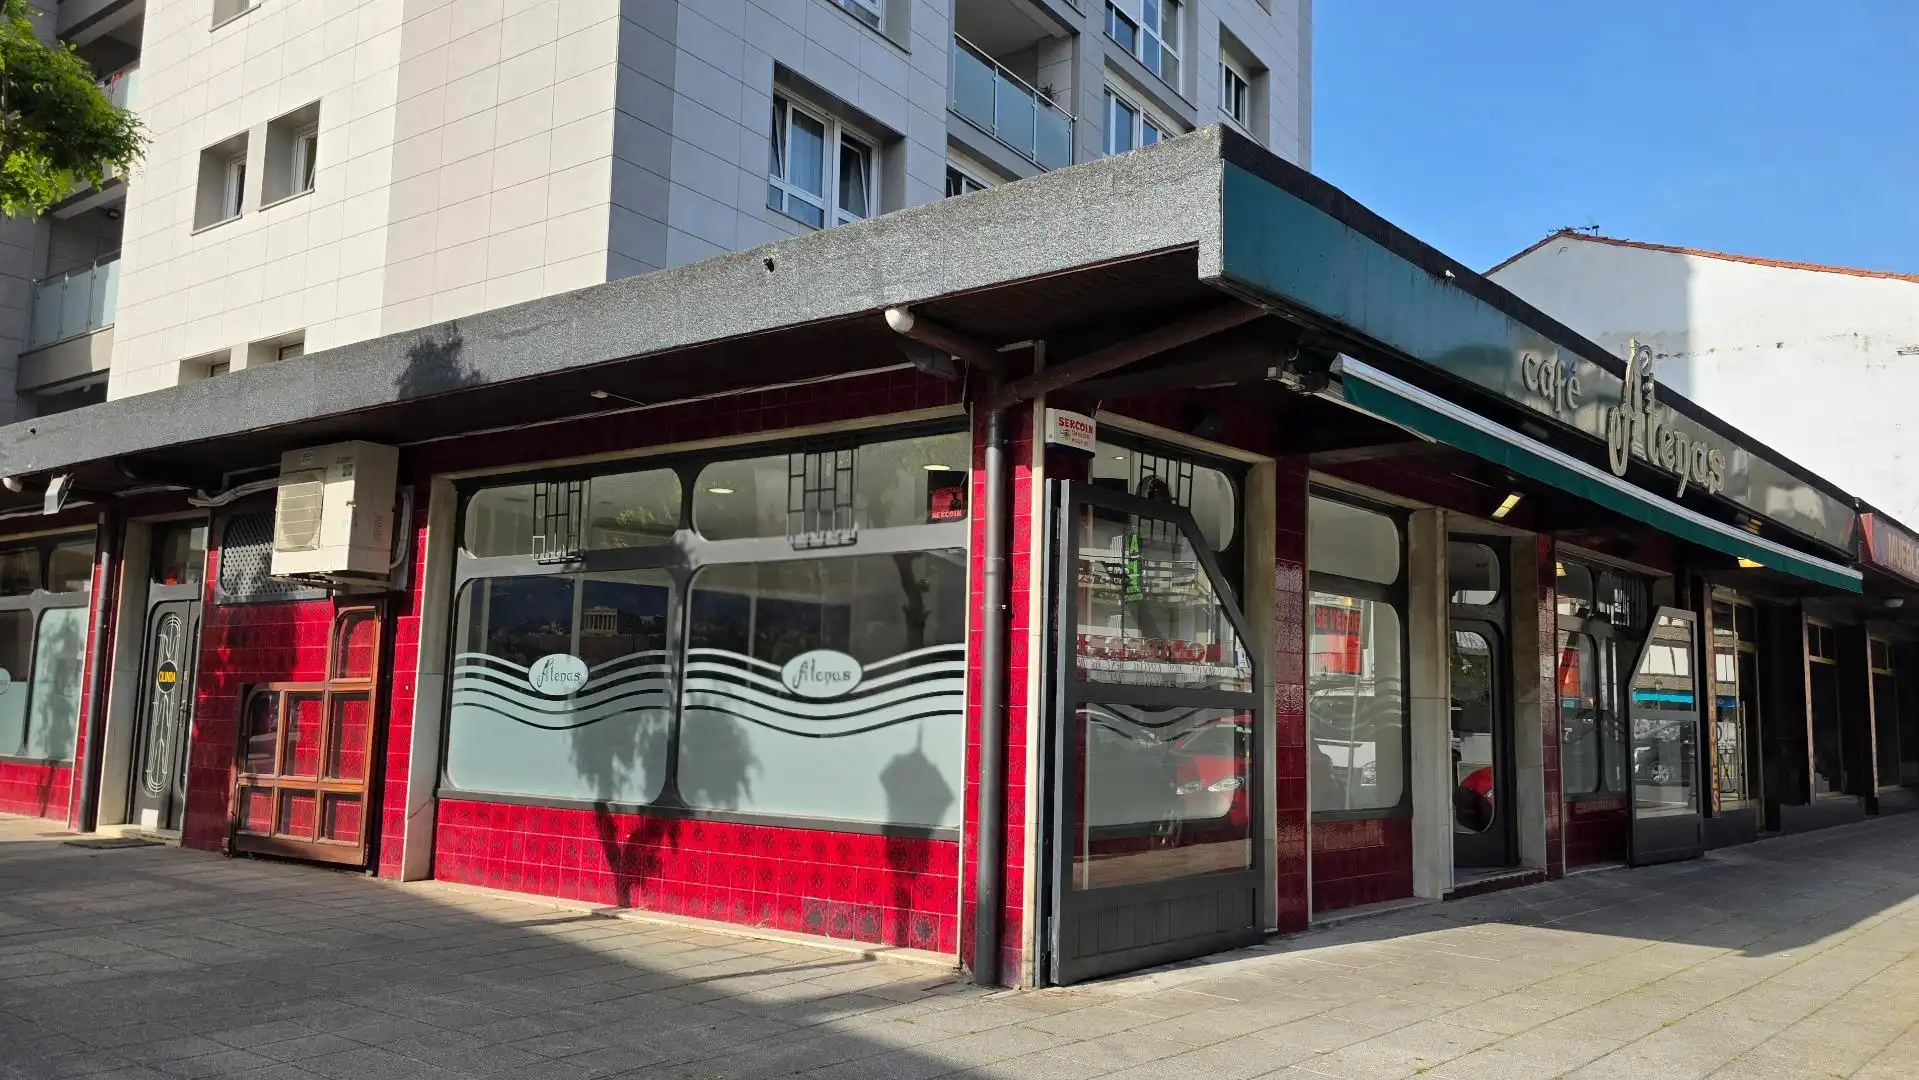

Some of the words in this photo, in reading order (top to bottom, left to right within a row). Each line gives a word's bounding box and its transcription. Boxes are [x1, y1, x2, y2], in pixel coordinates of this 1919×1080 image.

[1058, 416, 1094, 435] SERCOIN
[1522, 353, 1582, 412] café
[1609, 337, 1725, 498] Atenas
[931, 510, 962, 519] SERCOIN
[537, 658, 581, 688] Atenas
[792, 656, 852, 689] Atenas
